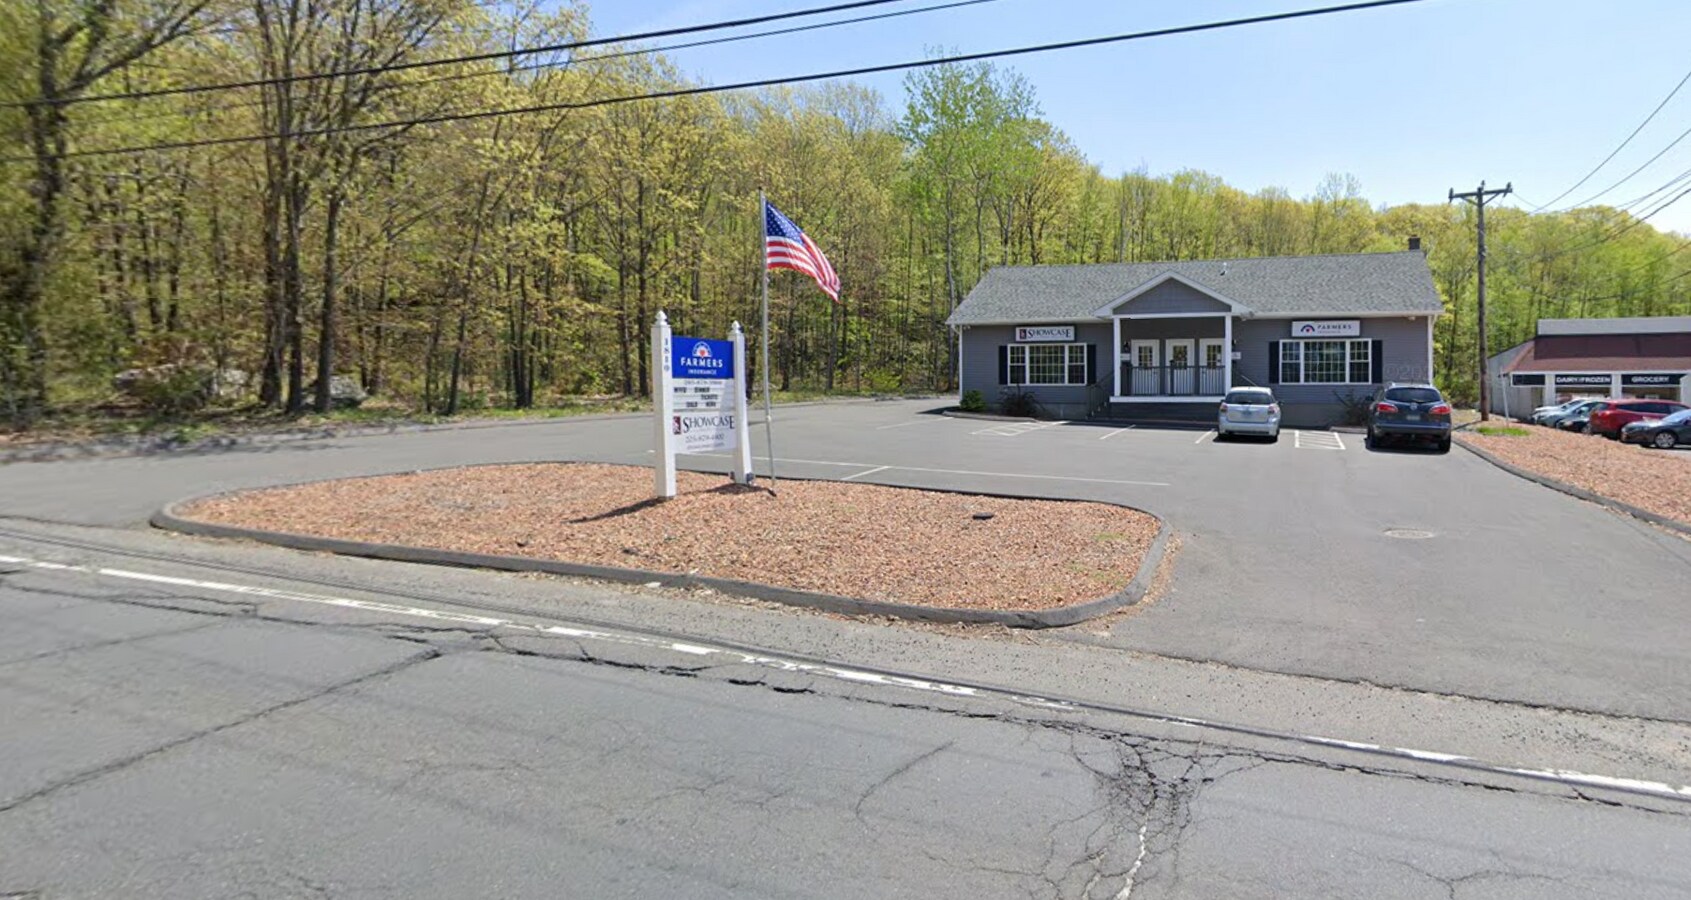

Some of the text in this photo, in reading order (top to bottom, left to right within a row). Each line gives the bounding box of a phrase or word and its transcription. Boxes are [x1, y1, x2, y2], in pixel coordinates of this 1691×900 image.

[1027, 328, 1072, 339] SHOWCASE
[680, 356, 723, 368] FARMERS
[683, 416, 735, 433] SHOWCASE
